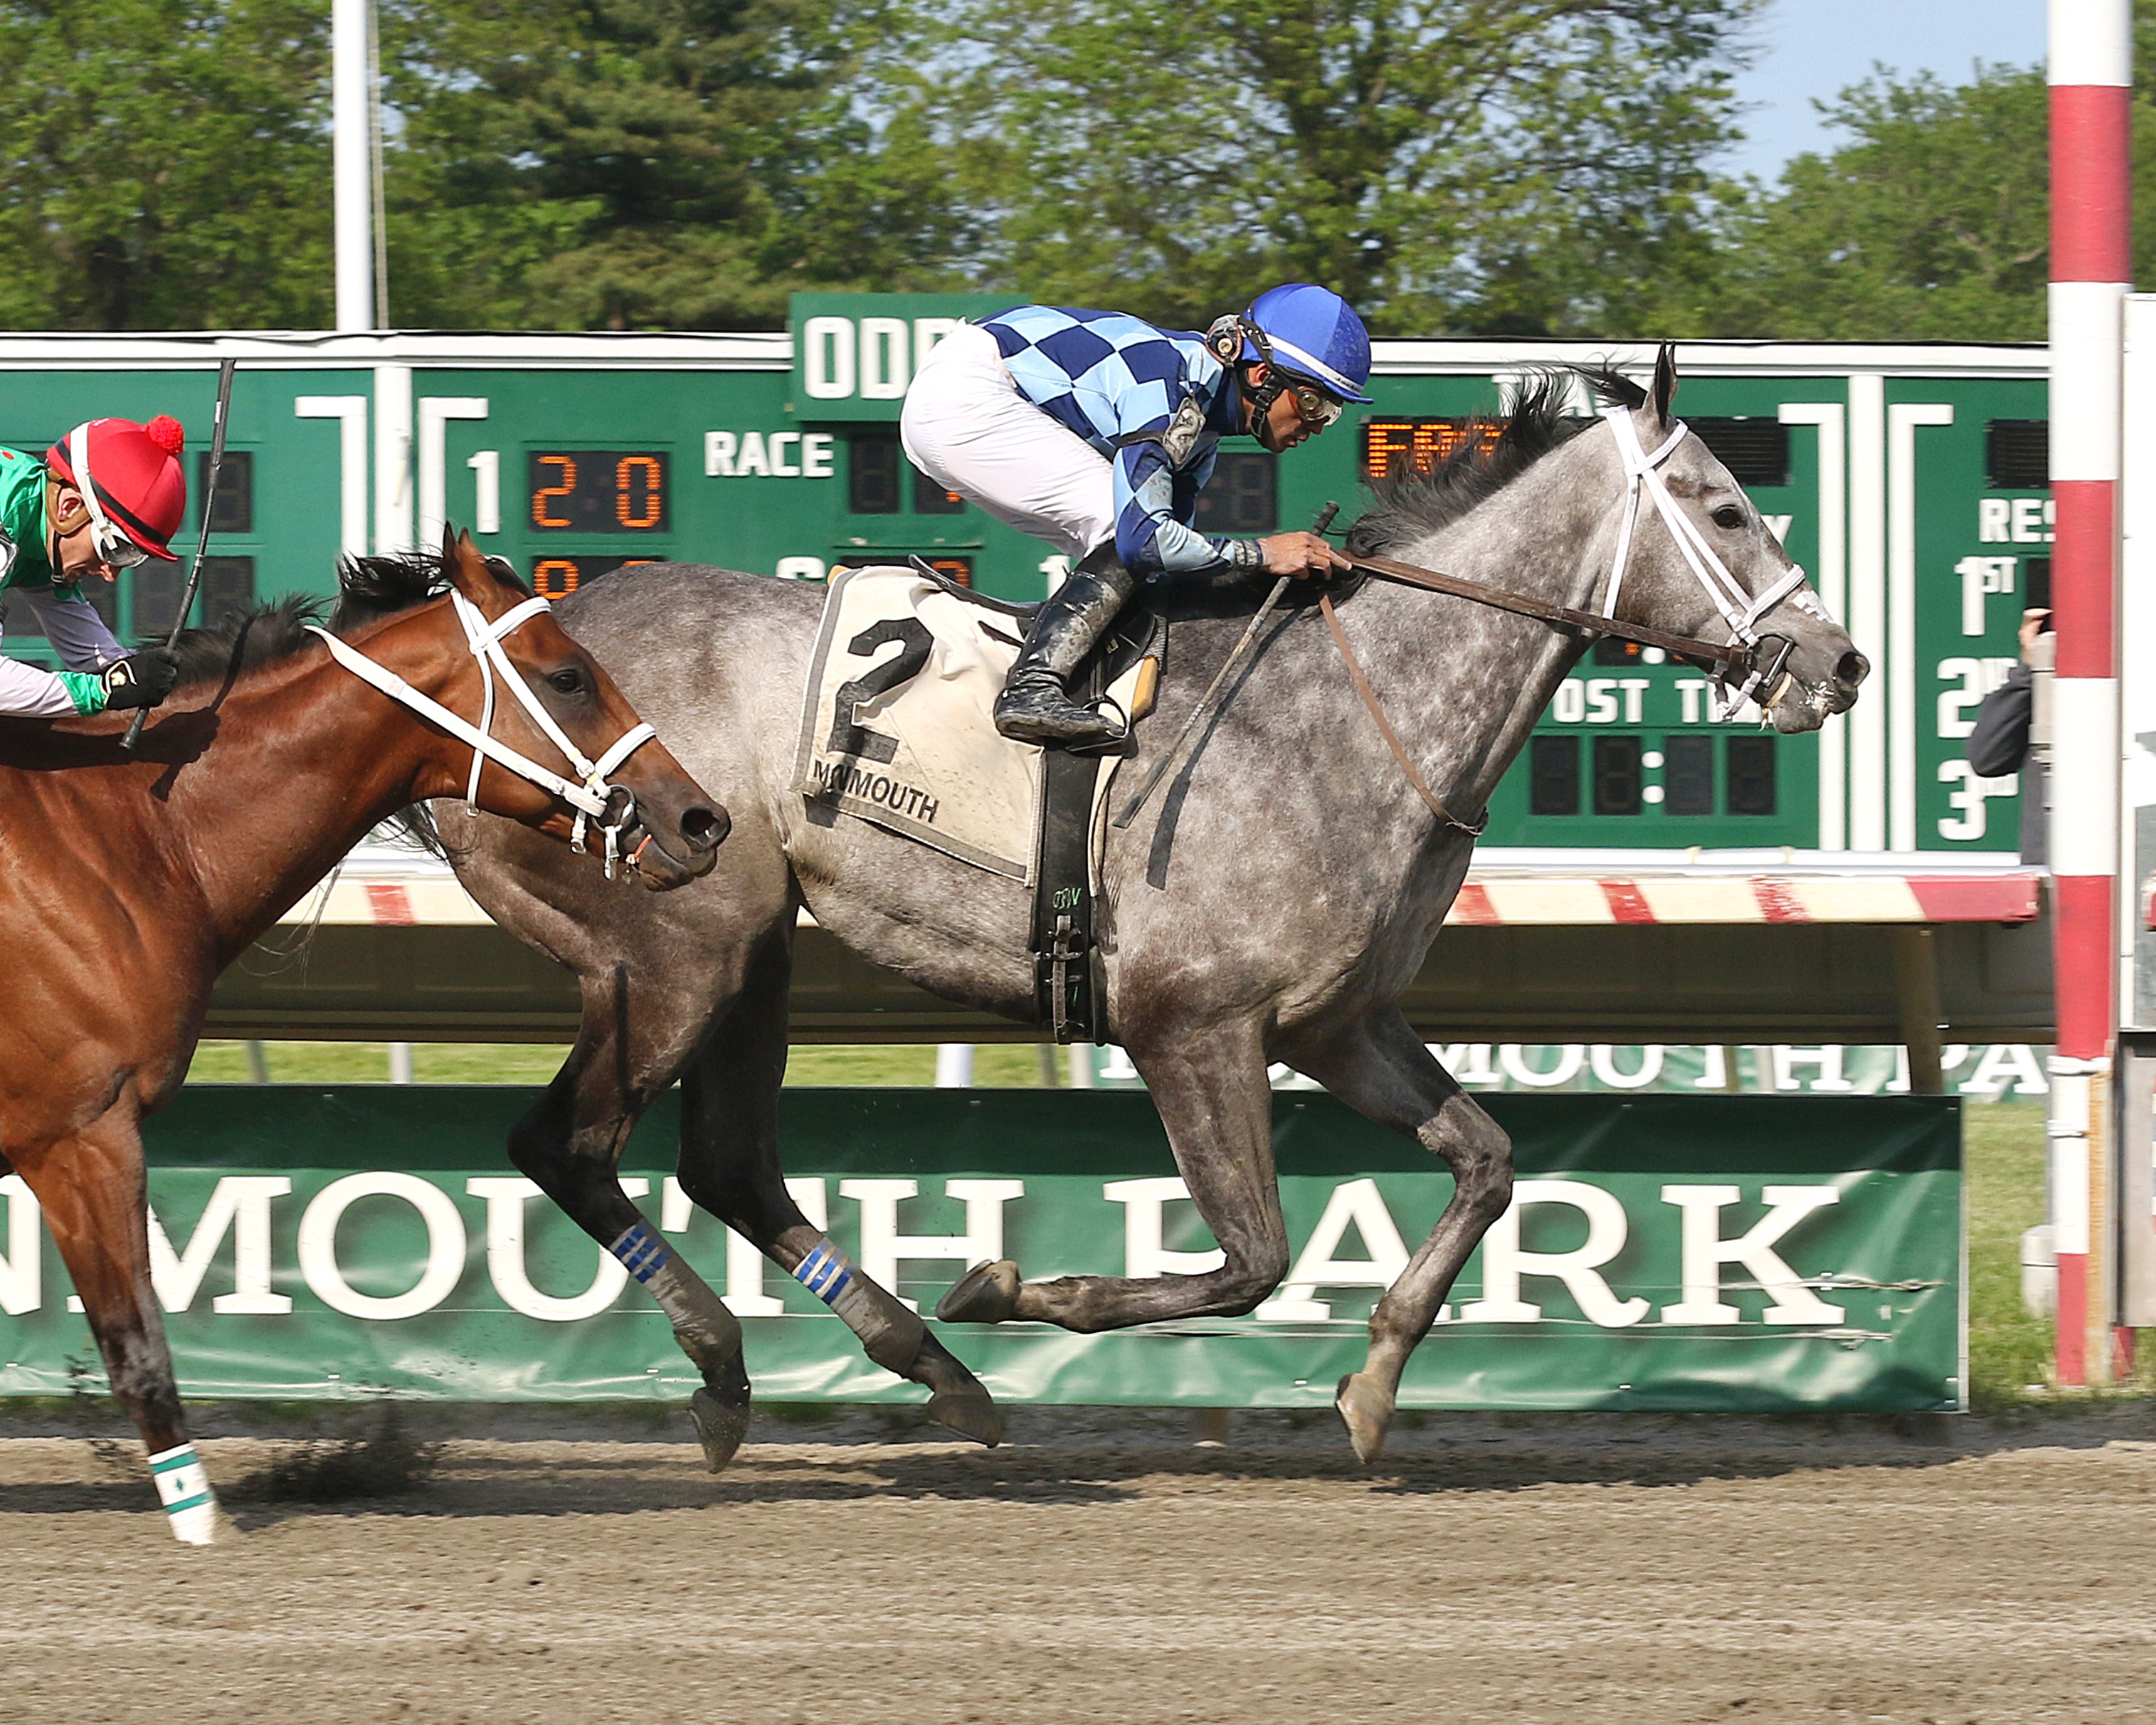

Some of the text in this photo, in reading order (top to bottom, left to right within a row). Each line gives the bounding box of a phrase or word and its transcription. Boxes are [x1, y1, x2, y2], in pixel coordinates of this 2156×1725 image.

[467, 450, 500, 533] 1
[704, 431, 835, 477] RACE
[826, 617, 934, 766] 2
